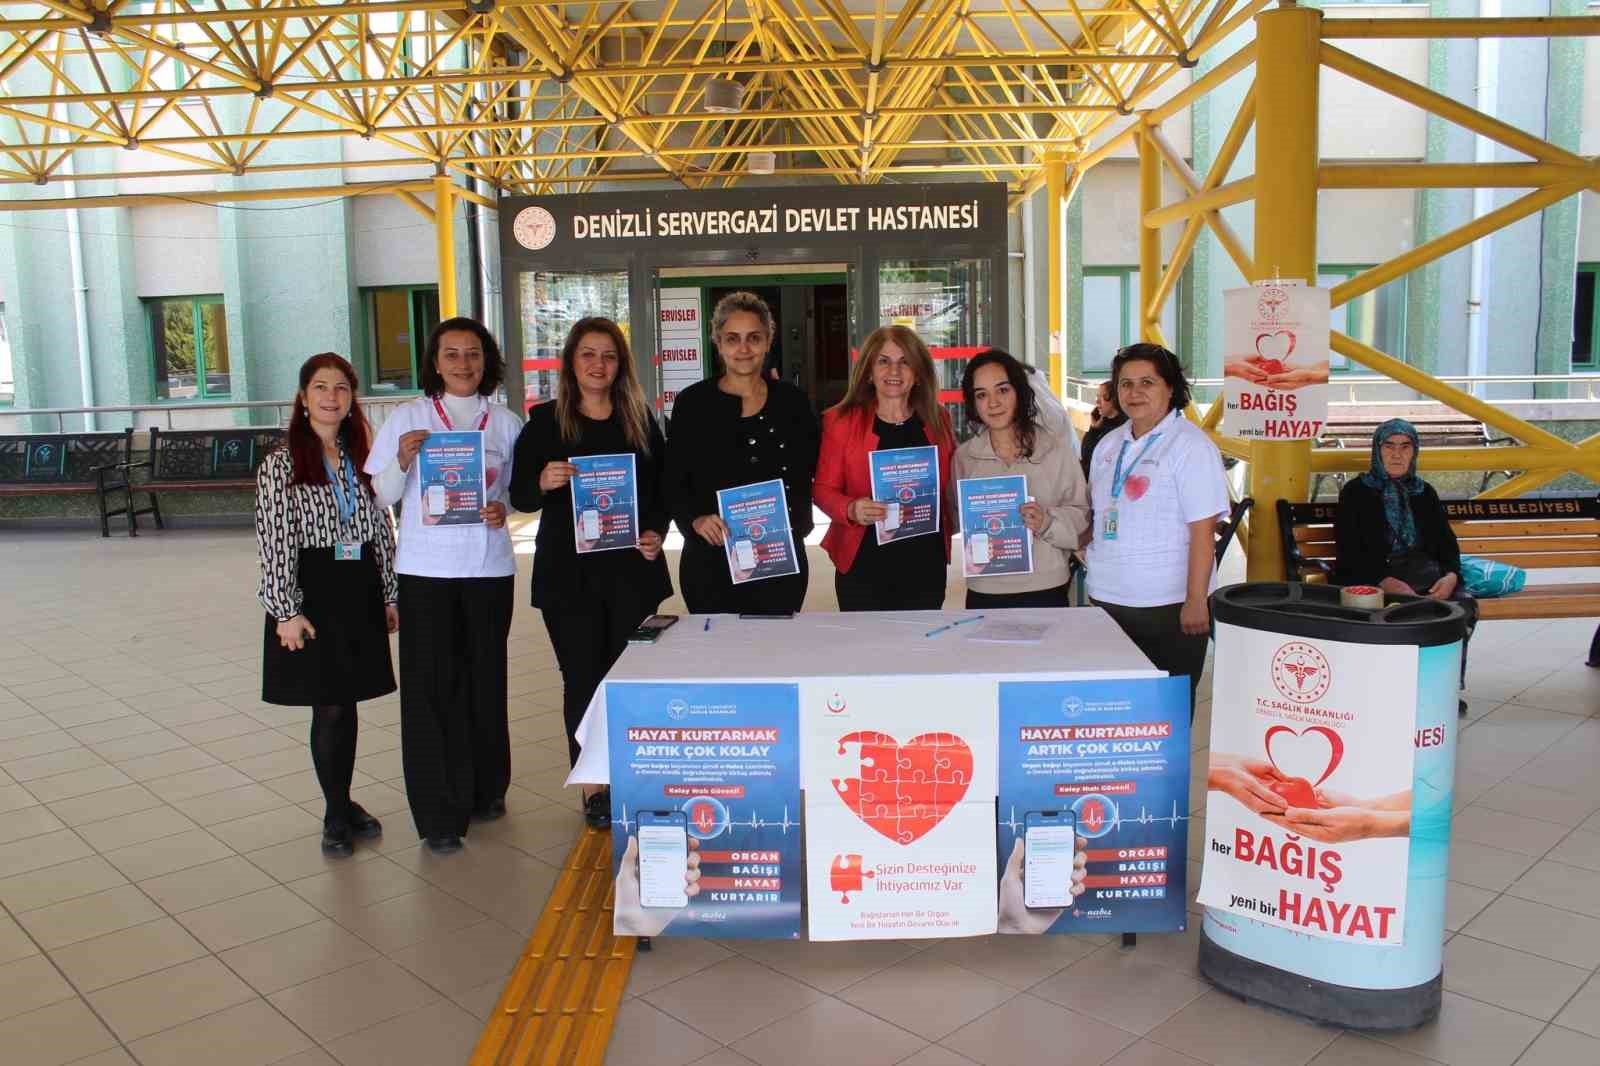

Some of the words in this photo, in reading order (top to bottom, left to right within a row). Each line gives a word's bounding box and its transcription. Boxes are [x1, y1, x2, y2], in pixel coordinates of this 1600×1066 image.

[573, 208, 652, 240] DENİZLİ
[657, 204, 778, 237] SERVERGAZİ
[785, 207, 860, 233] DEVLET
[867, 200, 979, 231] HASTANESİ
[1240, 390, 1297, 416] BAĞIŞ
[1265, 419, 1322, 438] HAYAT
[1488, 503, 1581, 514] BELEDİYESİ
[628, 729, 678, 741] HAYAT
[681, 729, 777, 741] KURTARMAK
[1020, 727, 1073, 740] HAYAT
[1075, 724, 1168, 739] KURTARMAK
[635, 745, 680, 757] ARTIK
[684, 745, 717, 759] ÇOK
[720, 745, 769, 757] KOLAY
[1027, 743, 1073, 756] ARTIK
[1077, 743, 1108, 757] ÇOK
[1112, 741, 1161, 753] KOLAY
[731, 852, 779, 861] ORGAN
[1119, 849, 1165, 858] ORGAN
[1119, 861, 1164, 872] BAĞIŞI
[1212, 839, 1232, 856] her
[1235, 828, 1343, 893] BAĞIŞ
[731, 864, 779, 876] BAĞIŞI
[876, 863, 904, 875] Sizin
[734, 879, 778, 888] HAYAT
[943, 880, 963, 891] Var
[1120, 876, 1164, 885] HAYAT
[711, 892, 778, 902] KURTARIR
[1097, 890, 1164, 899] KURTARIR
[1229, 894, 1257, 912] yeni
[1260, 900, 1278, 917] bir
[1279, 889, 1397, 939] HAYAT
